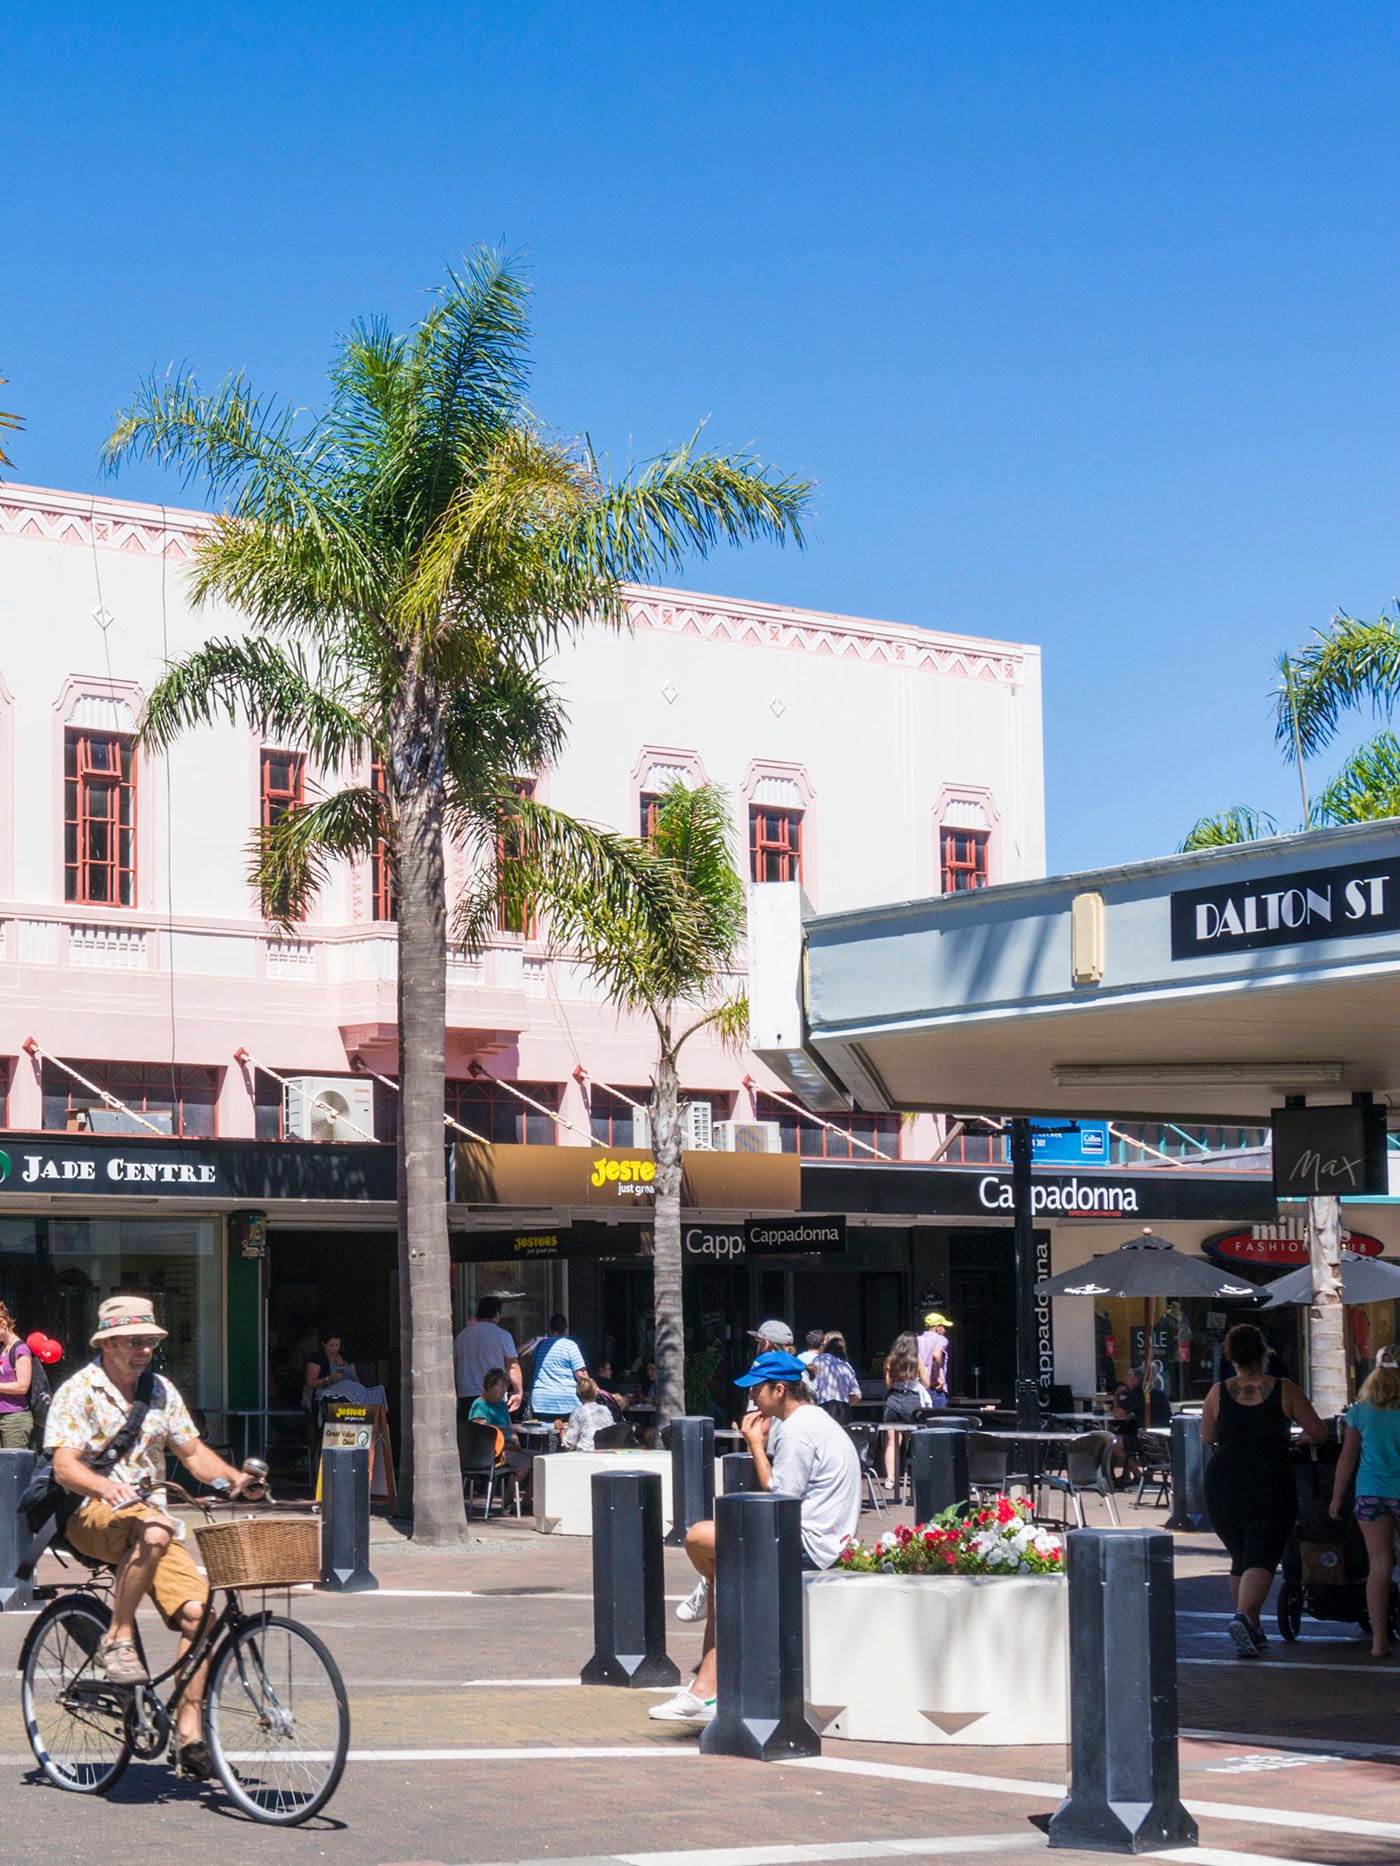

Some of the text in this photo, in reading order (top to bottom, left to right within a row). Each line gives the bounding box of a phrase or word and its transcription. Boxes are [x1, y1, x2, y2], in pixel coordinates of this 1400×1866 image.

[1196, 876, 1390, 941] DALTON ST
[22, 1155, 216, 1183] JADE CENTRE
[591, 1157, 656, 1187] JeSTe
[1289, 1150, 1362, 1191] Max
[618, 1183, 655, 1196] just grea
[979, 1176, 1138, 1216] Capadonna
[750, 1226, 839, 1246] Cappadonna
[1252, 1215, 1352, 1242] mills
[686, 1229, 745, 1259] Capp
[1136, 1331, 1168, 1347] SLE
